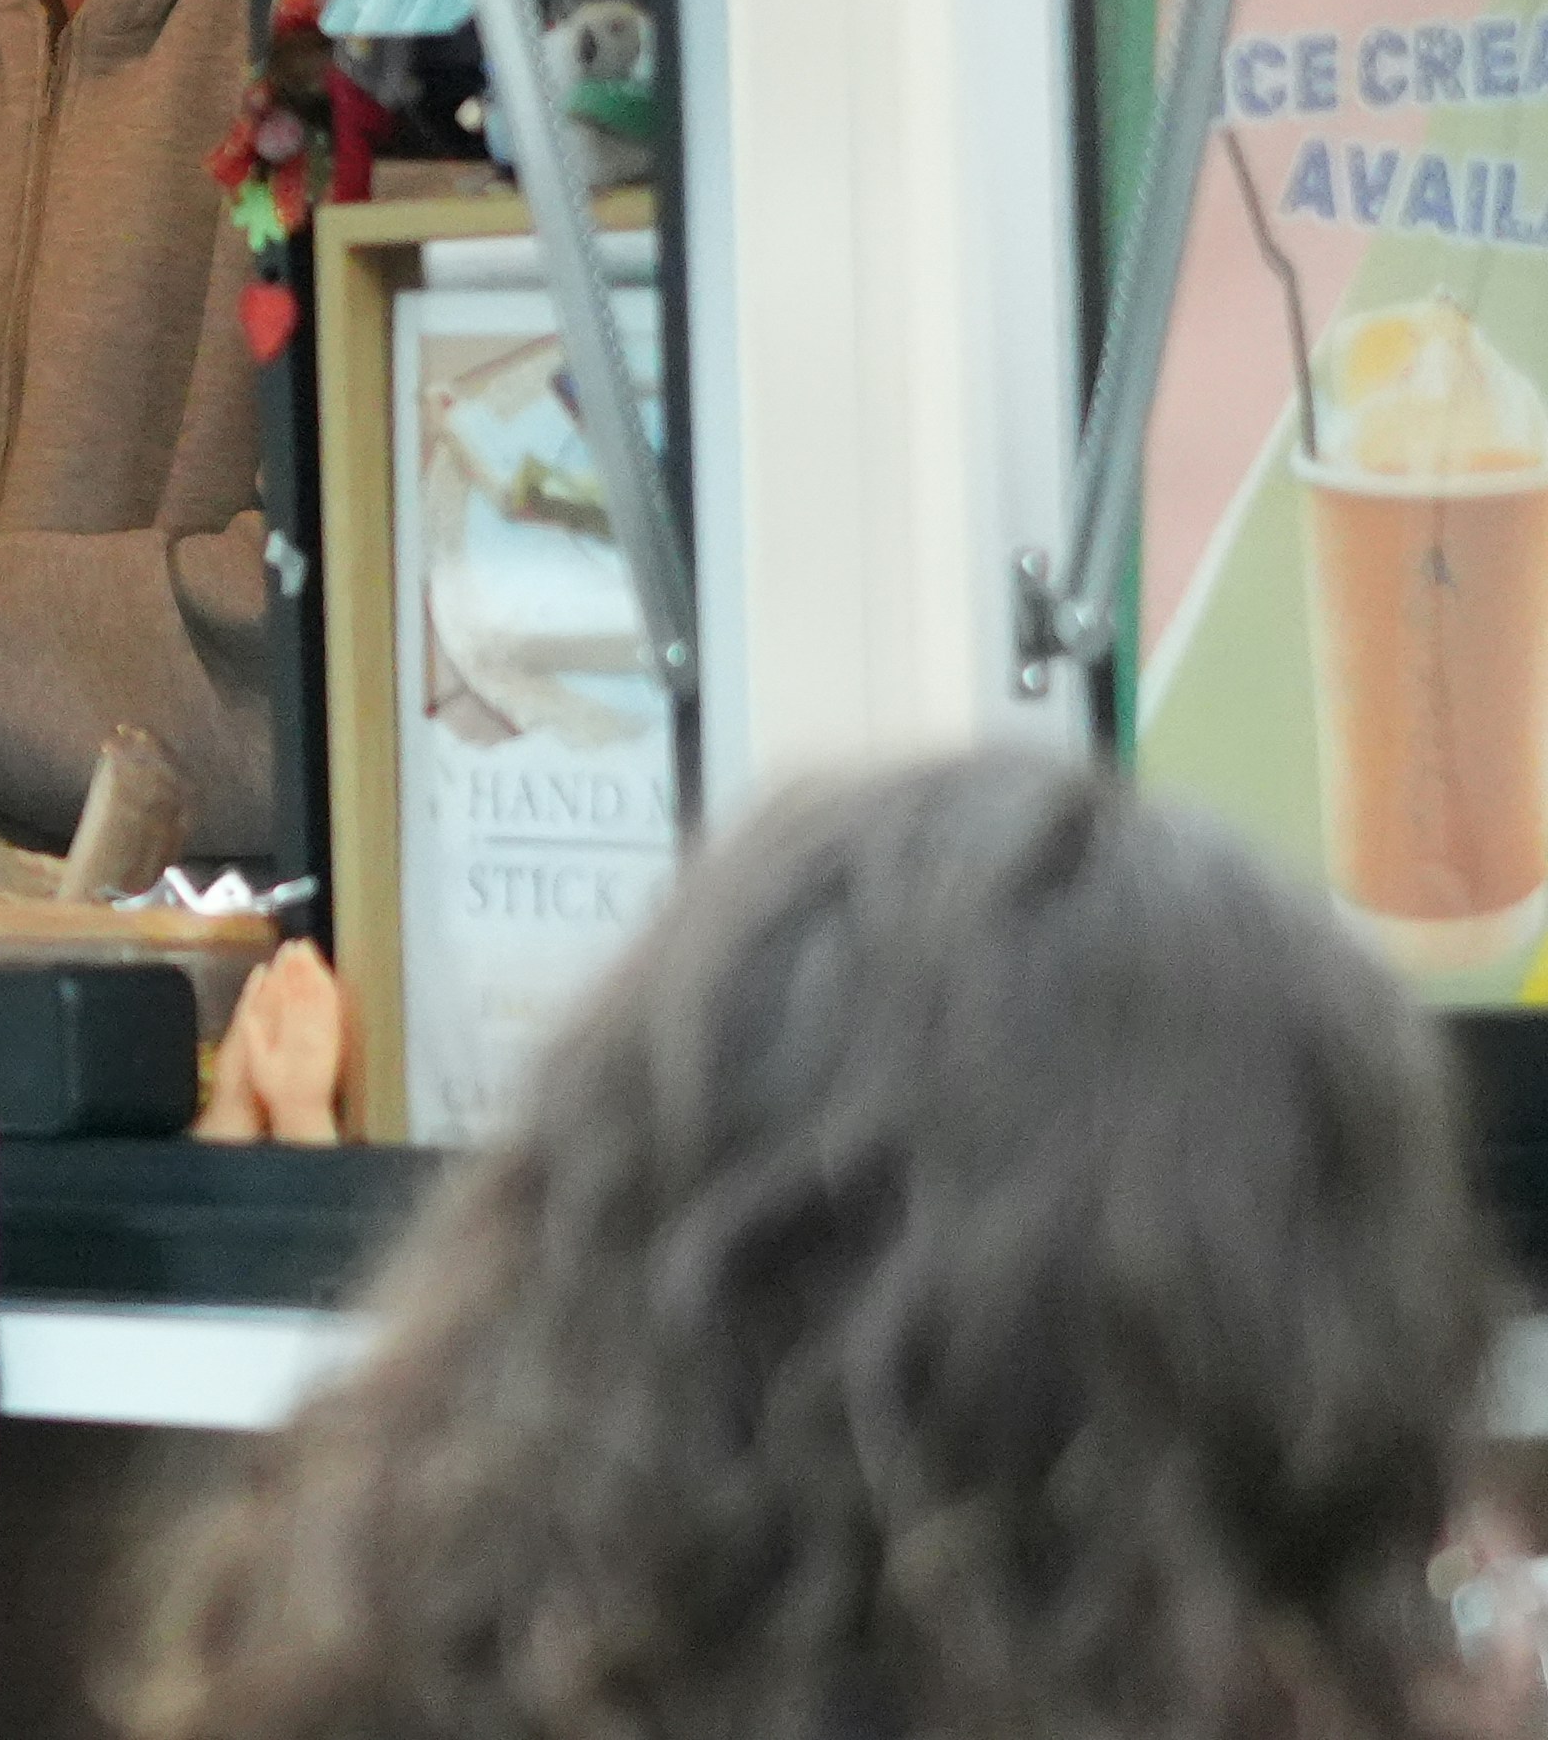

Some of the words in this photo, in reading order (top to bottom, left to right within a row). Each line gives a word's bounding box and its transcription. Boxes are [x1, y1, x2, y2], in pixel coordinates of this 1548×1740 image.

[1218, 34, 1339, 120] CE
[1278, 139, 1548, 245] AVAIL
[467, 768, 624, 822] HAND
[466, 864, 620, 921] STICK
